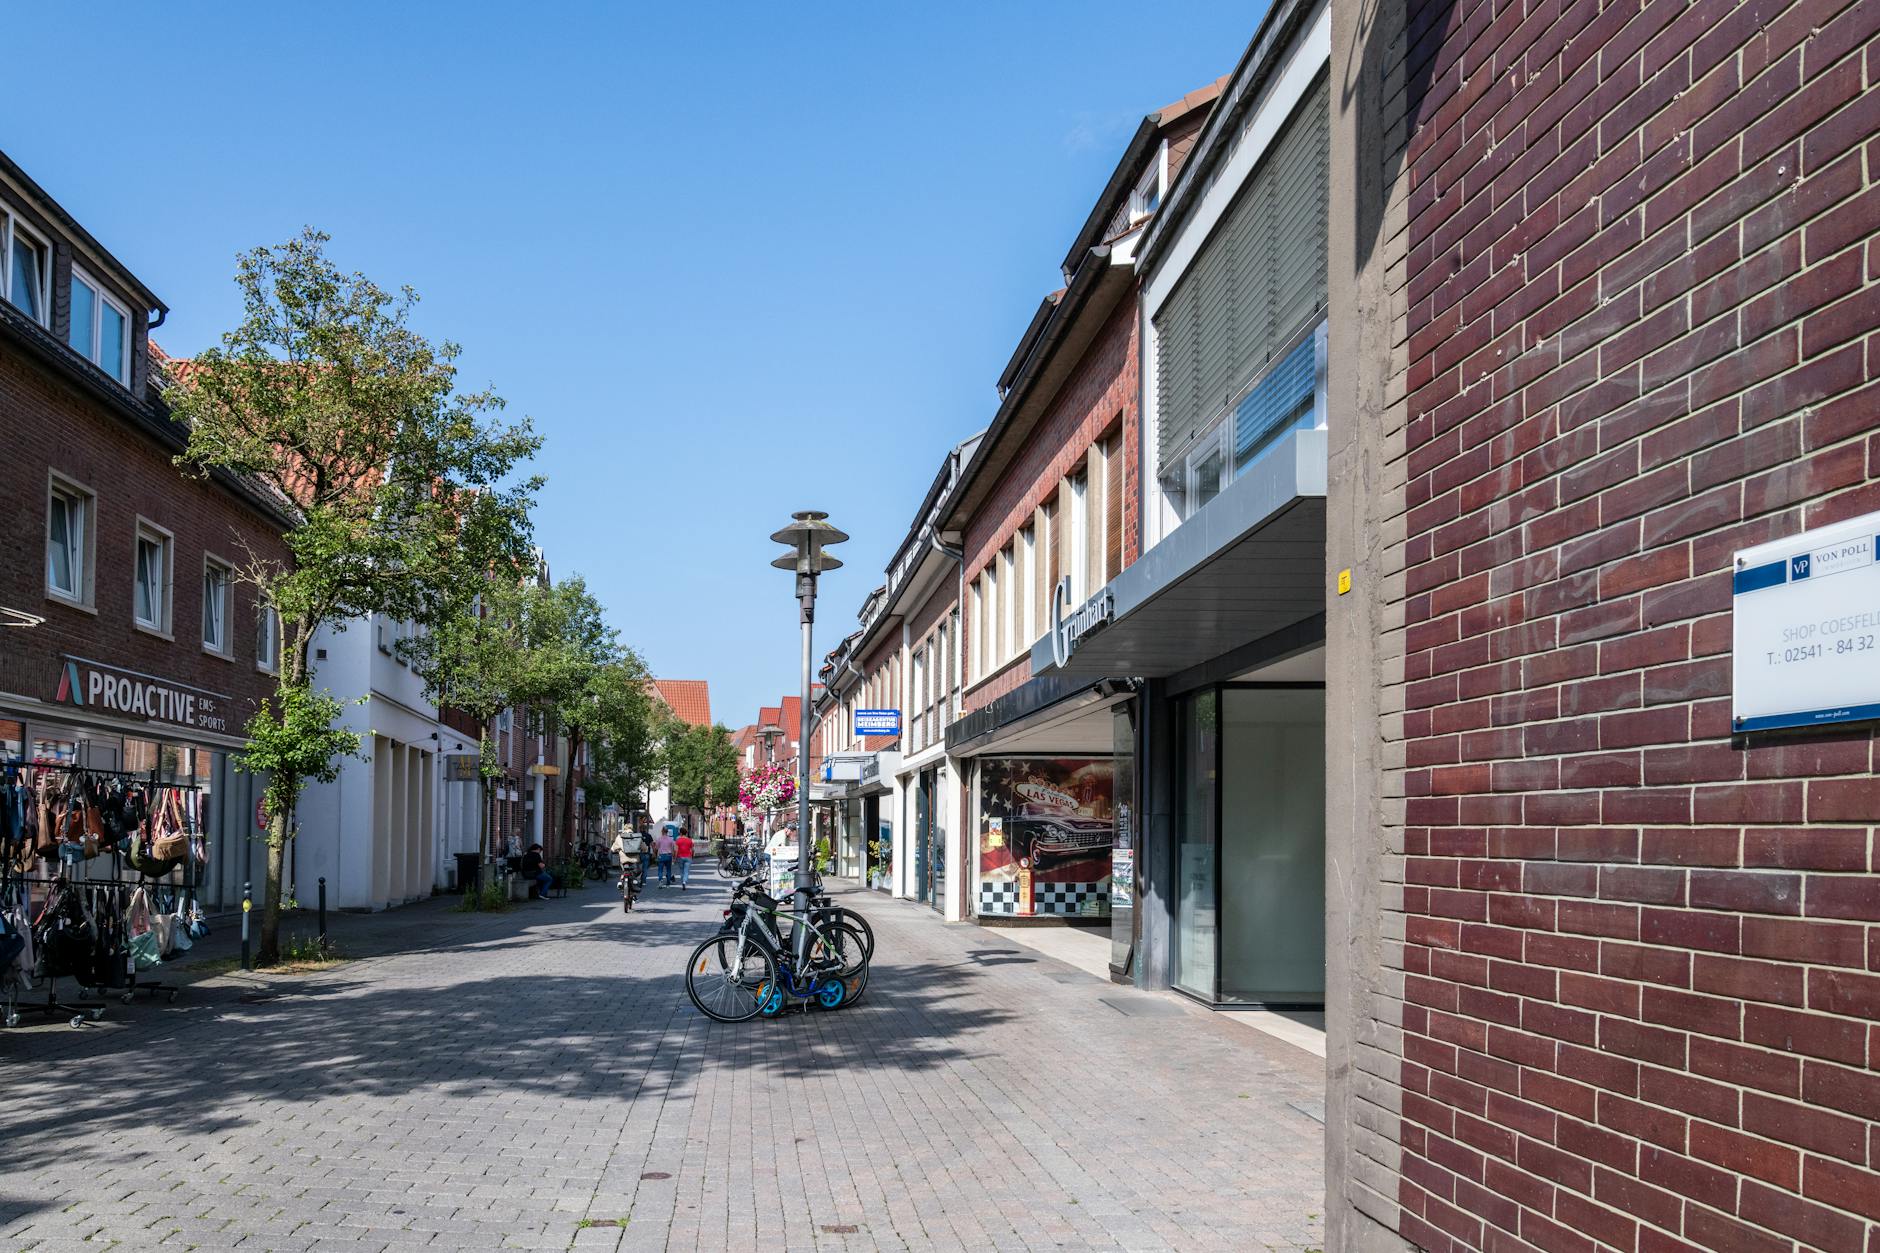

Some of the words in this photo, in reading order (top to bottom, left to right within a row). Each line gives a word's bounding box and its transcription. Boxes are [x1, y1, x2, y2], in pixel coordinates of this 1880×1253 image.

[1816, 550, 1838, 563] VON
[1842, 543, 1870, 558] POLL
[1783, 623, 1816, 642] SHOP
[1785, 643, 1822, 662] 02541
[1837, 638, 1853, 654] 84
[1858, 634, 1874, 651] 32
[88, 670, 195, 725] PROACTIVE
[198, 697, 217, 713] EMS-
[198, 714, 226, 732] SPORTS
[1026, 788, 1046, 801] LAS
[1048, 795, 1074, 809] VEGAS
